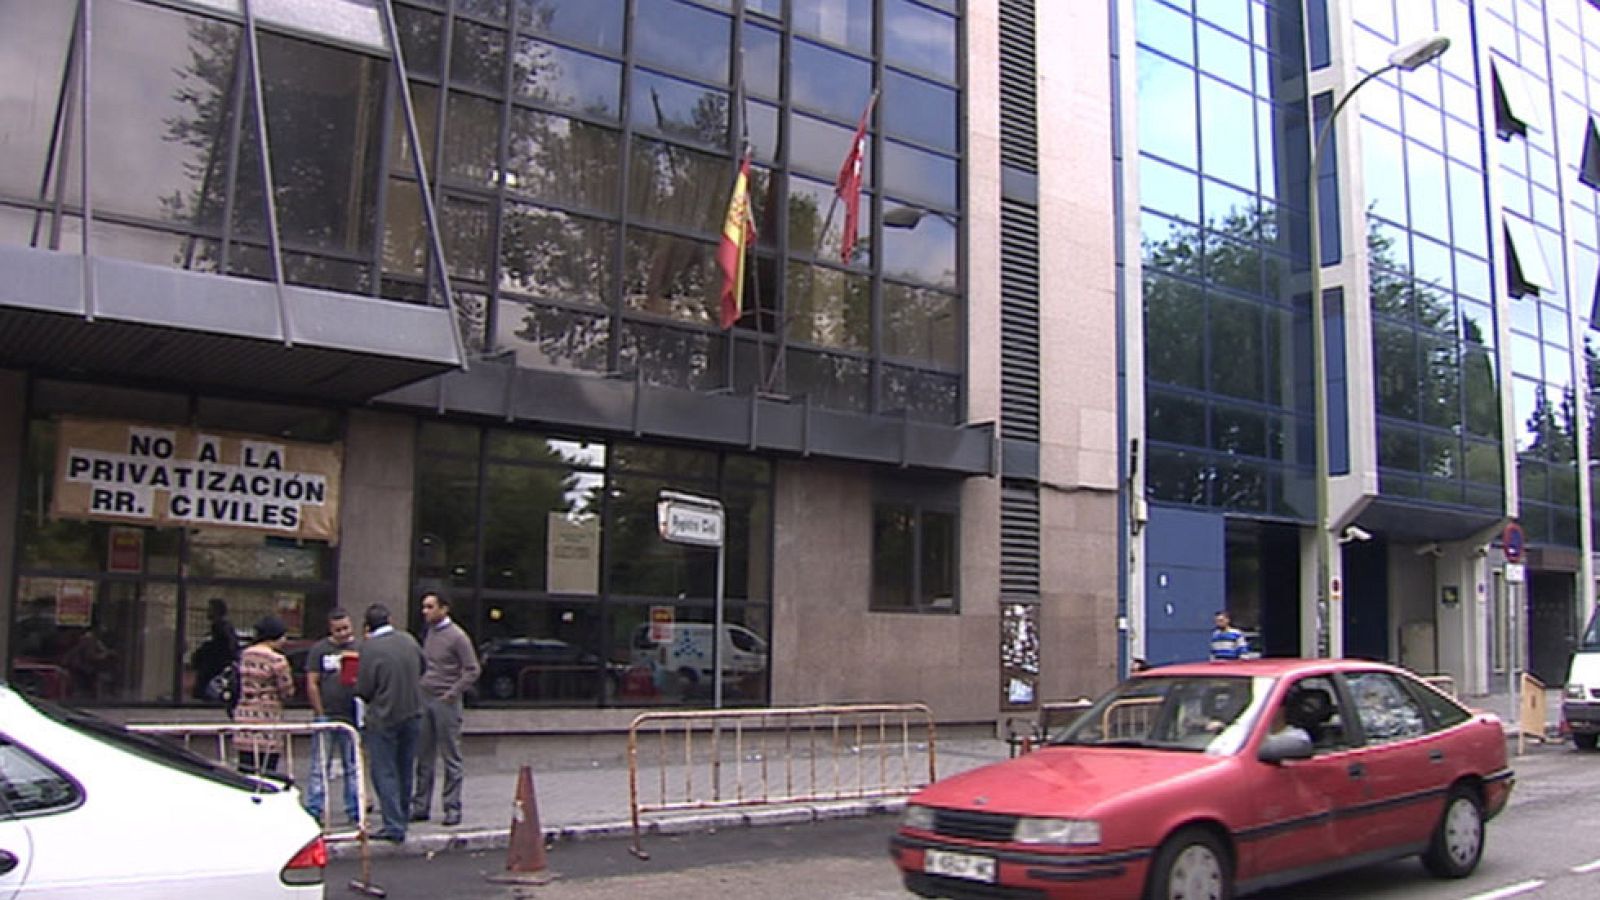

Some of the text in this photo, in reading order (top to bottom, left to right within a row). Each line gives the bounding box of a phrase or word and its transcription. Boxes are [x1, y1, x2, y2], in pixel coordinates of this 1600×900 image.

[130, 434, 282, 471] NO A LA
[69, 456, 324, 502] PRIVATIZACIÓN
[92, 489, 298, 527] RR. CIVILES
